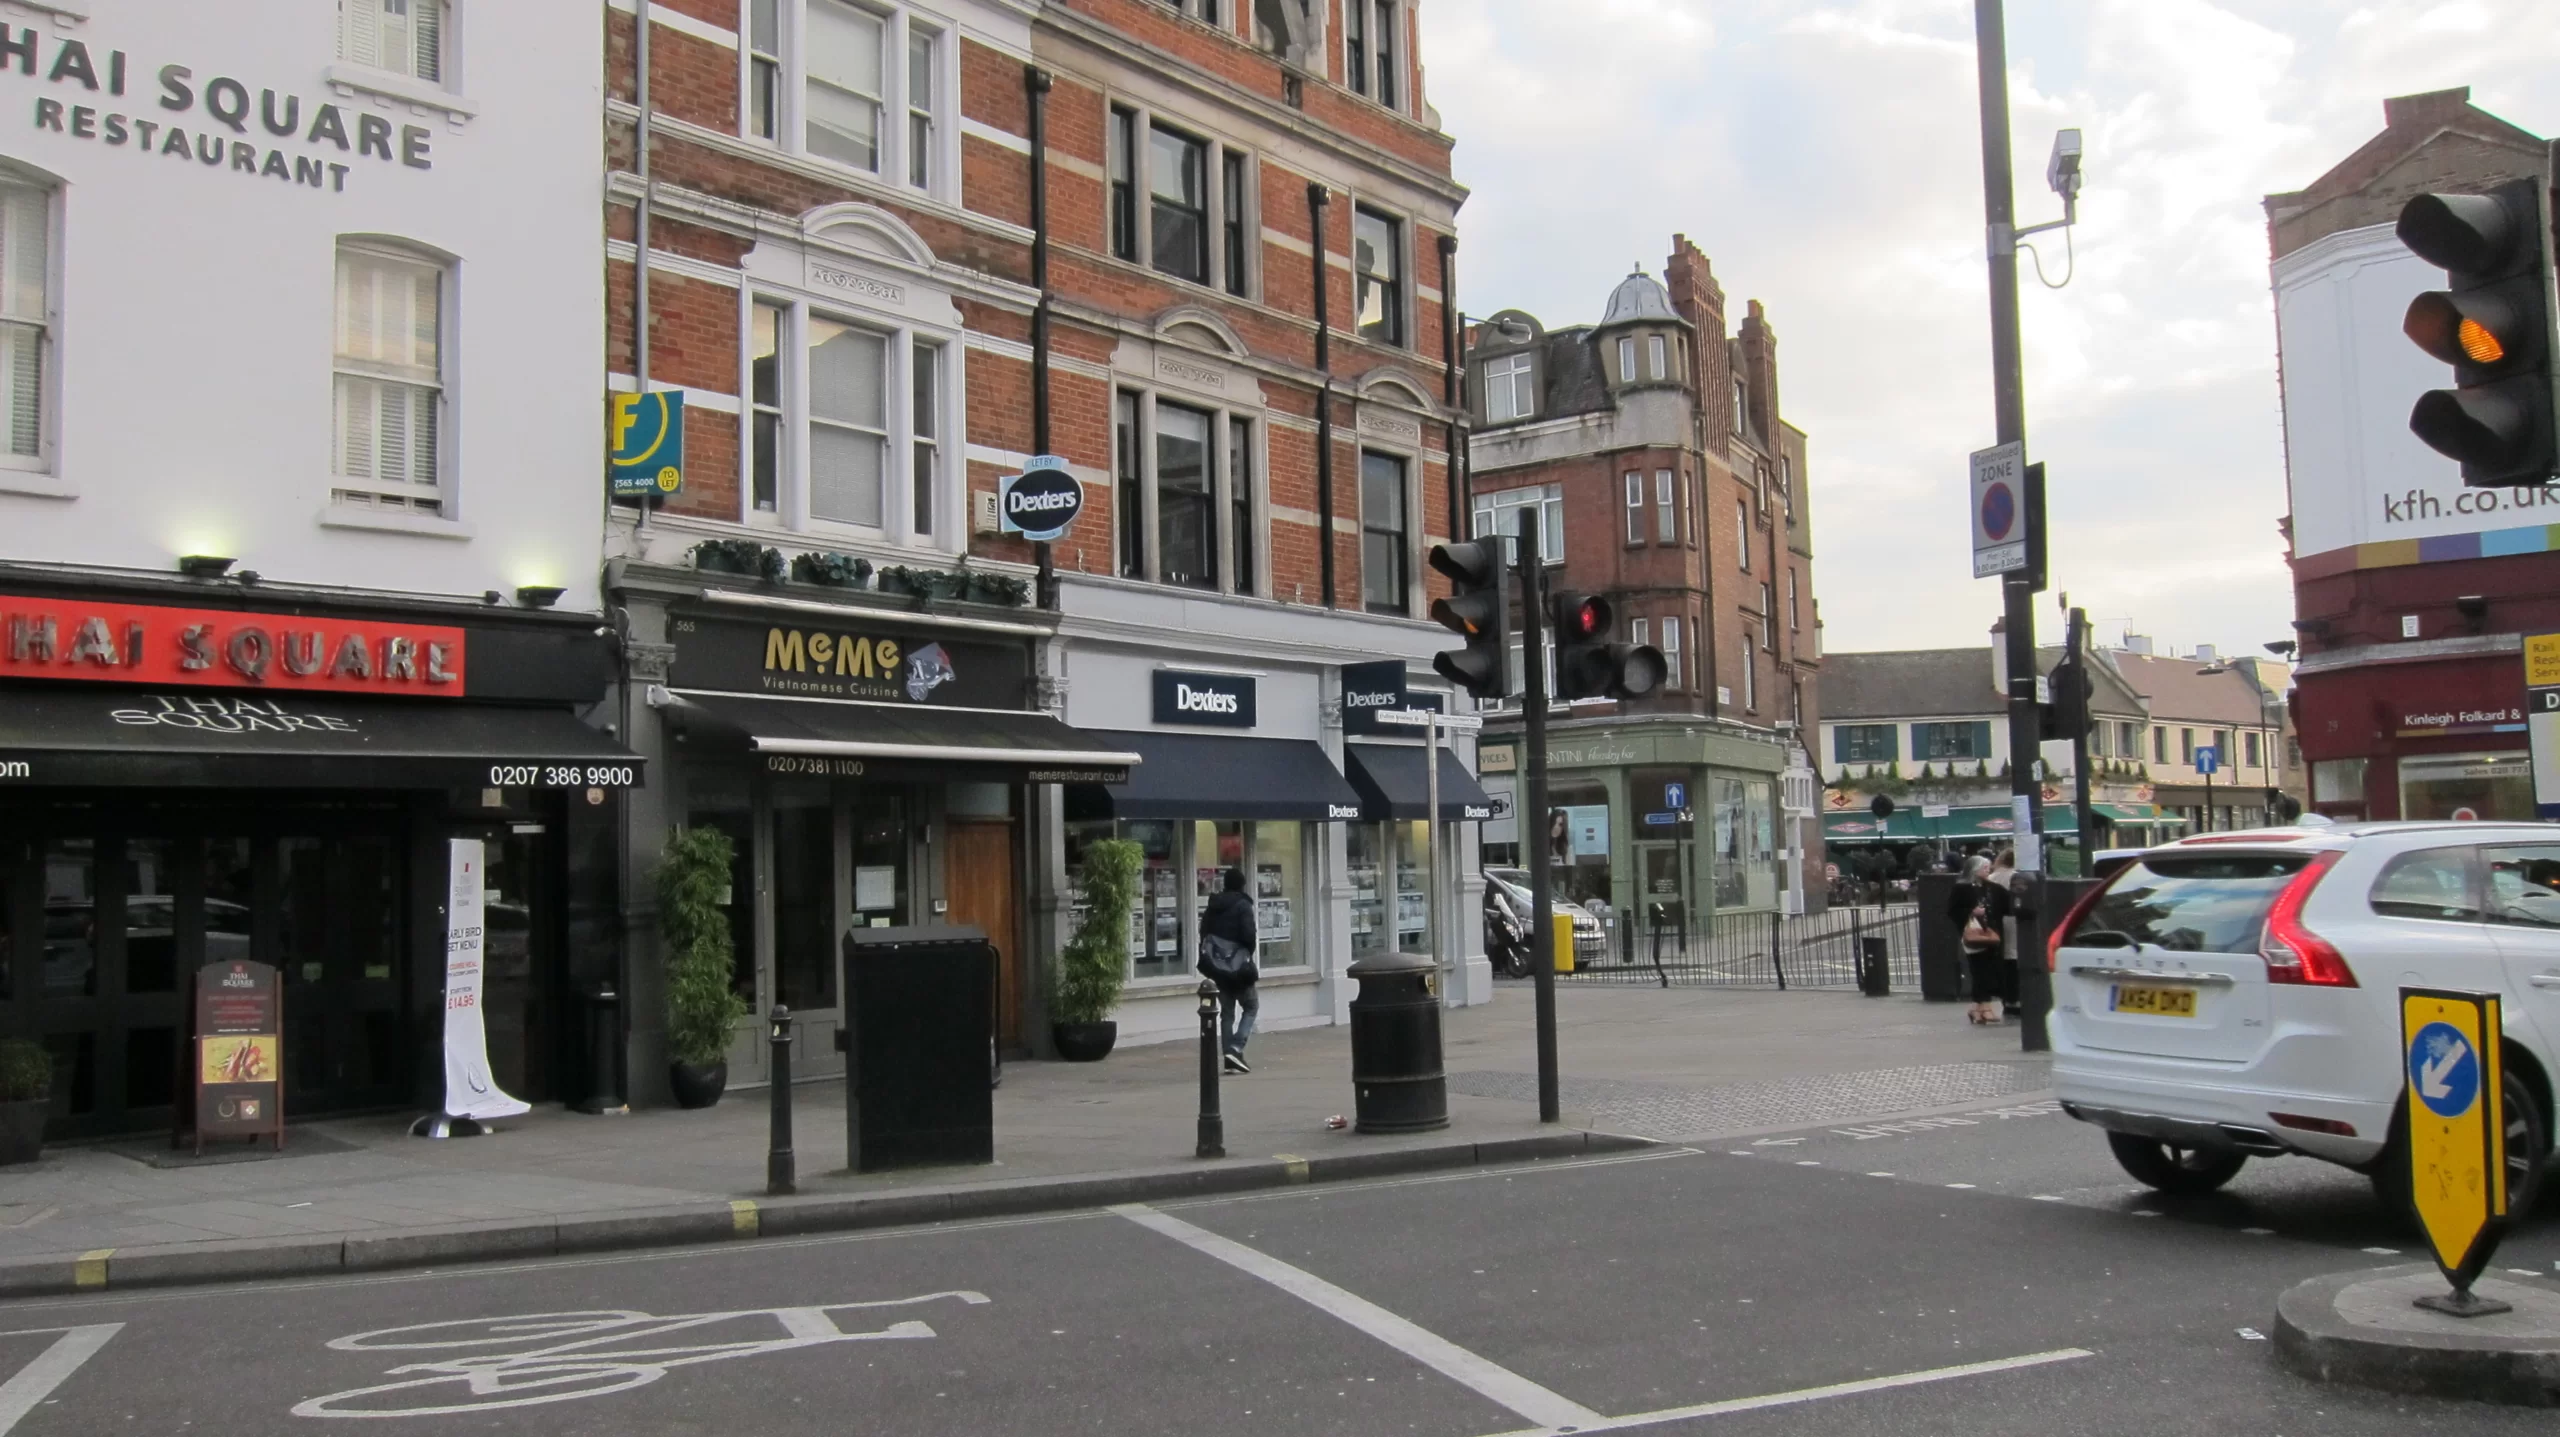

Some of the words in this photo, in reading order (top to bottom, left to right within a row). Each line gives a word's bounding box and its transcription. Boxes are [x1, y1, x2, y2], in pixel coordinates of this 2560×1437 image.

[158, 63, 432, 171] SQUARE
[36, 96, 350, 192] RESTAURANT
[1032, 458, 1044, 467] LET
[1045, 457, 1053, 466] BY
[635, 477, 655, 486] 4000
[663, 470, 674, 478] TO
[1981, 461, 2012, 483] ZONE
[662, 479, 674, 488] LET
[1010, 490, 1076, 513] Dexters
[677, 620, 695, 632] 565
[179, 624, 458, 682] SQUARE
[763, 677, 843, 694] Vietnamese
[850, 683, 899, 698] Cuisine
[1177, 684, 1237, 714] Dexters
[1347, 691, 1396, 707] Dexters
[111, 710, 358, 733] SQUARE
[2405, 712, 2454, 727] Kinleigh
[2459, 709, 2506, 722] Folkard
[2511, 708, 2521, 720] &
[491, 766, 539, 785] 0207
[545, 766, 582, 785] 386
[587, 767, 633, 785] 9900
[768, 756, 796, 772] 020
[799, 758, 830, 774] 7381
[836, 760, 863, 776] 1100
[2464, 767, 2488, 776] Sales
[1329, 804, 1358, 818] Dexters
[1465, 805, 1490, 818] Dexters
[448, 928, 464, 939] ARLY
